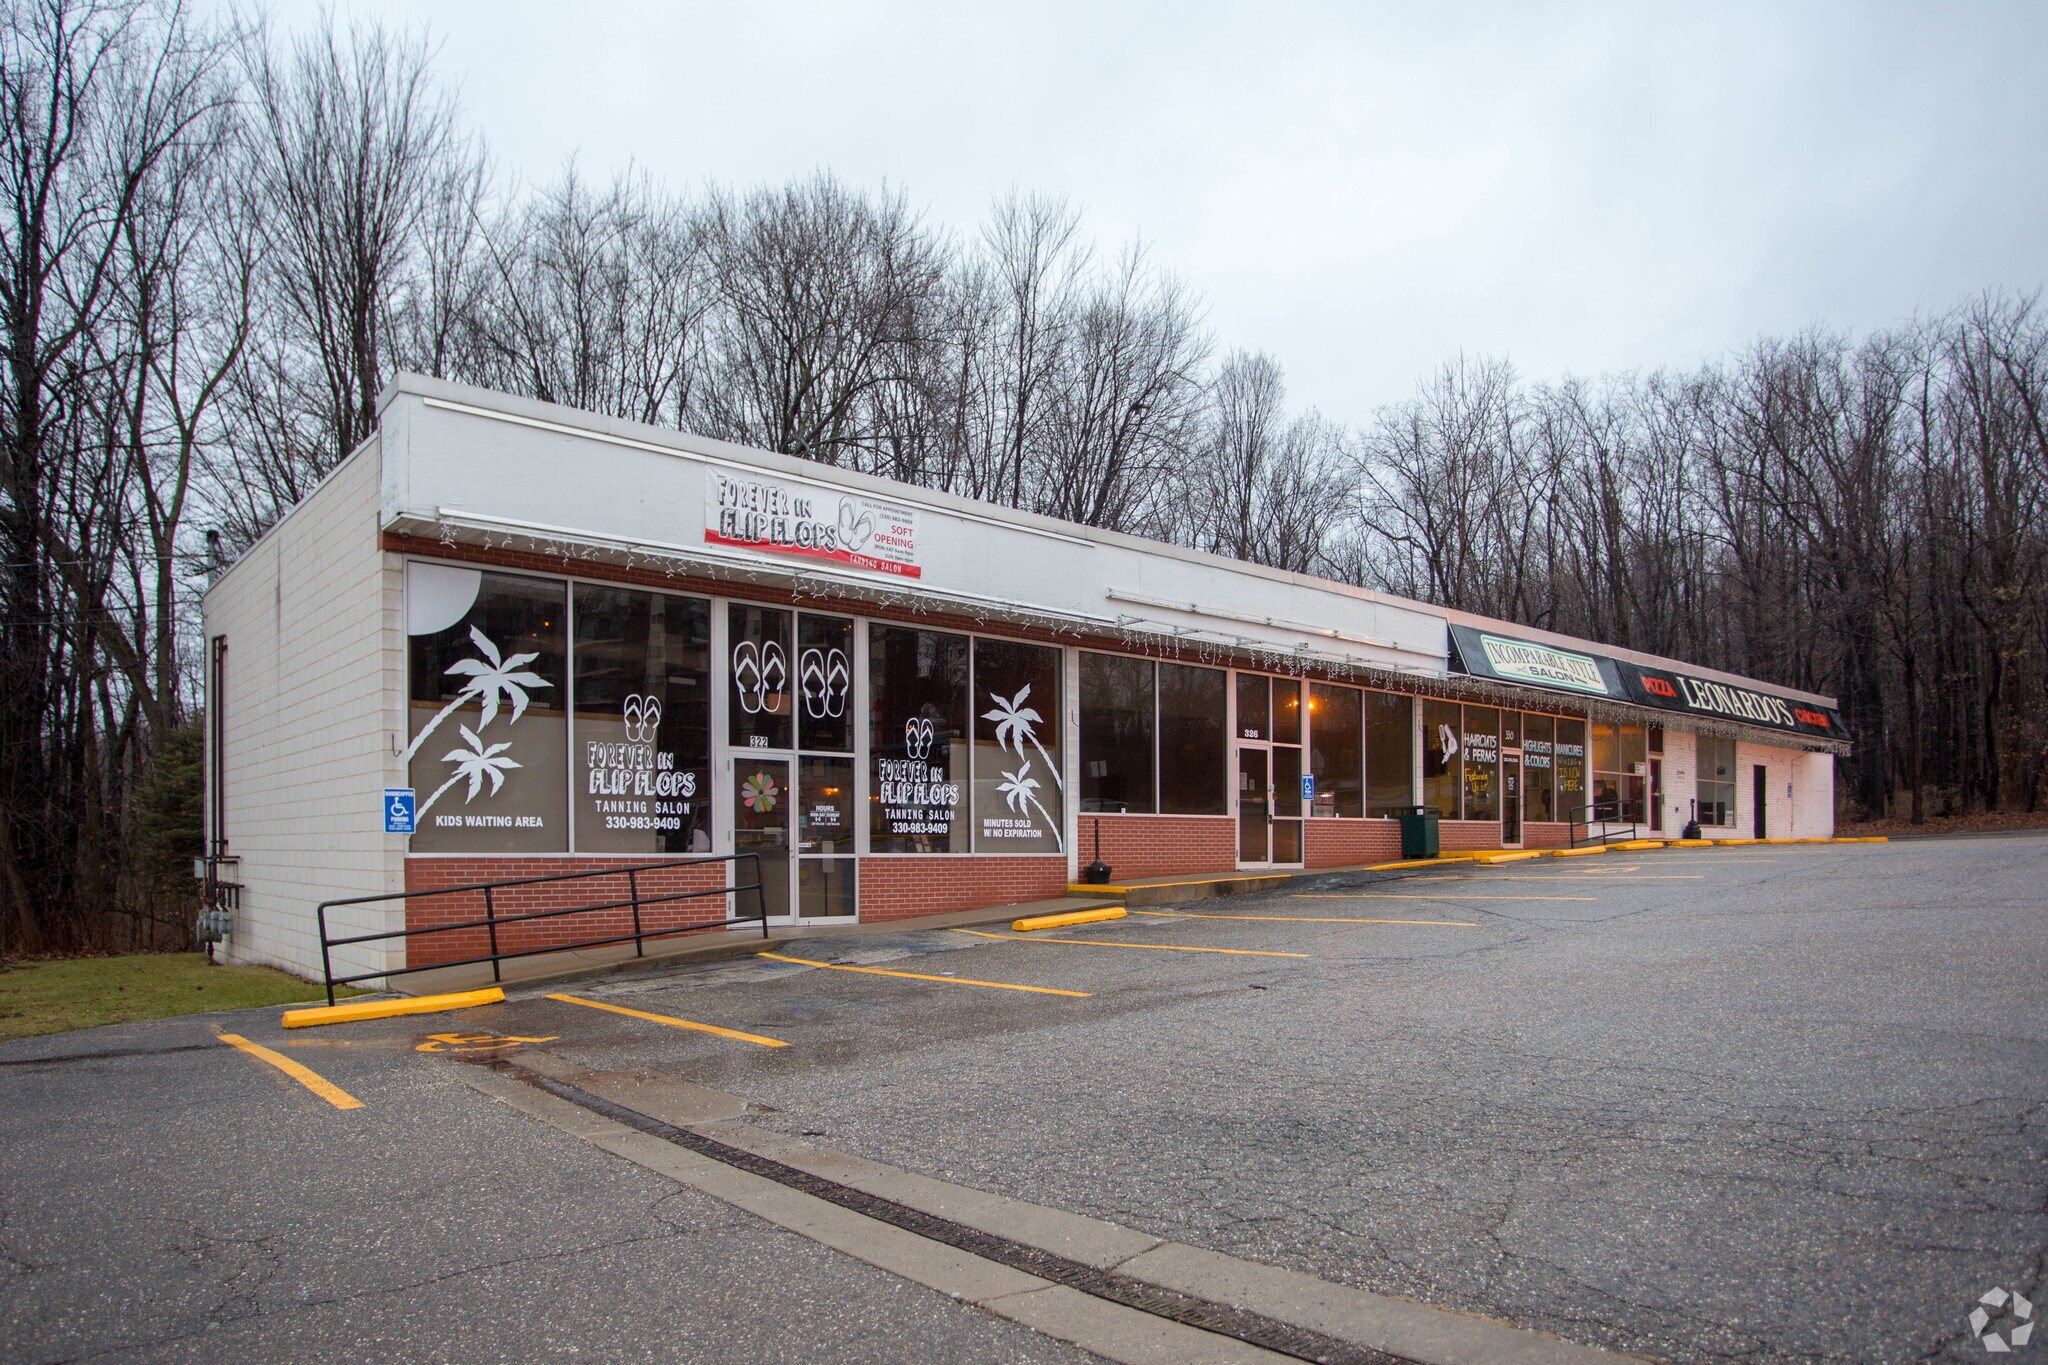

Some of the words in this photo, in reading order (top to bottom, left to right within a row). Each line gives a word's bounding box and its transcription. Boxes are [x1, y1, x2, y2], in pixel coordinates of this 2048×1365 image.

[717, 476, 789, 516] FOREVER
[794, 498, 812, 518] IN
[861, 501, 872, 509] CALL
[883, 506, 913, 517] APPOINTMENT
[719, 508, 768, 543] FLIP
[769, 516, 838, 554] FLOPS
[891, 525, 913, 537] SOFT
[874, 533, 914, 549] OPENING
[849, 554, 878, 569] TANNING
[880, 561, 902, 573] SALON
[1486, 641, 1569, 672] INCOMPARABLE
[1567, 658, 1601, 684] STYLE
[1529, 666, 1575, 683] SALON
[1641, 675, 1677, 698] PIZZA
[1676, 676, 1795, 727] LEONARDO'S
[751, 736, 767, 747] 322
[1464, 733, 1497, 749] HAIRCUTS
[1523, 739, 1552, 754] HIGHLIGHTS
[588, 741, 653, 770] FOREVER
[657, 751, 674, 770] IN
[1464, 747, 1470, 761] &
[1472, 748, 1497, 763] PERMS
[1556, 743, 1583, 757] MANICURES
[879, 758, 928, 782] FOREVER
[930, 766, 944, 782] IN
[589, 768, 634, 795] FLIP
[634, 770, 696, 797] FLOPS
[880, 781, 913, 805] FLIP
[913, 783, 960, 806] FLOPS
[595, 800, 647, 814] TANNING
[655, 802, 690, 814] SALON
[885, 808, 924, 820] TANNING
[928, 810, 955, 821] SALON
[436, 815, 463, 827] KIDS
[465, 815, 513, 827] WAITING
[515, 816, 544, 827] AREA
[605, 816, 681, 829] 330-983-9409
[892, 822, 948, 834] 330-983-9409
[983, 818, 1013, 828] MINUTES
[1014, 819, 1032, 828] SOLD
[992, 829, 1003, 838] NO
[1004, 829, 1042, 838] EXPIRATION
